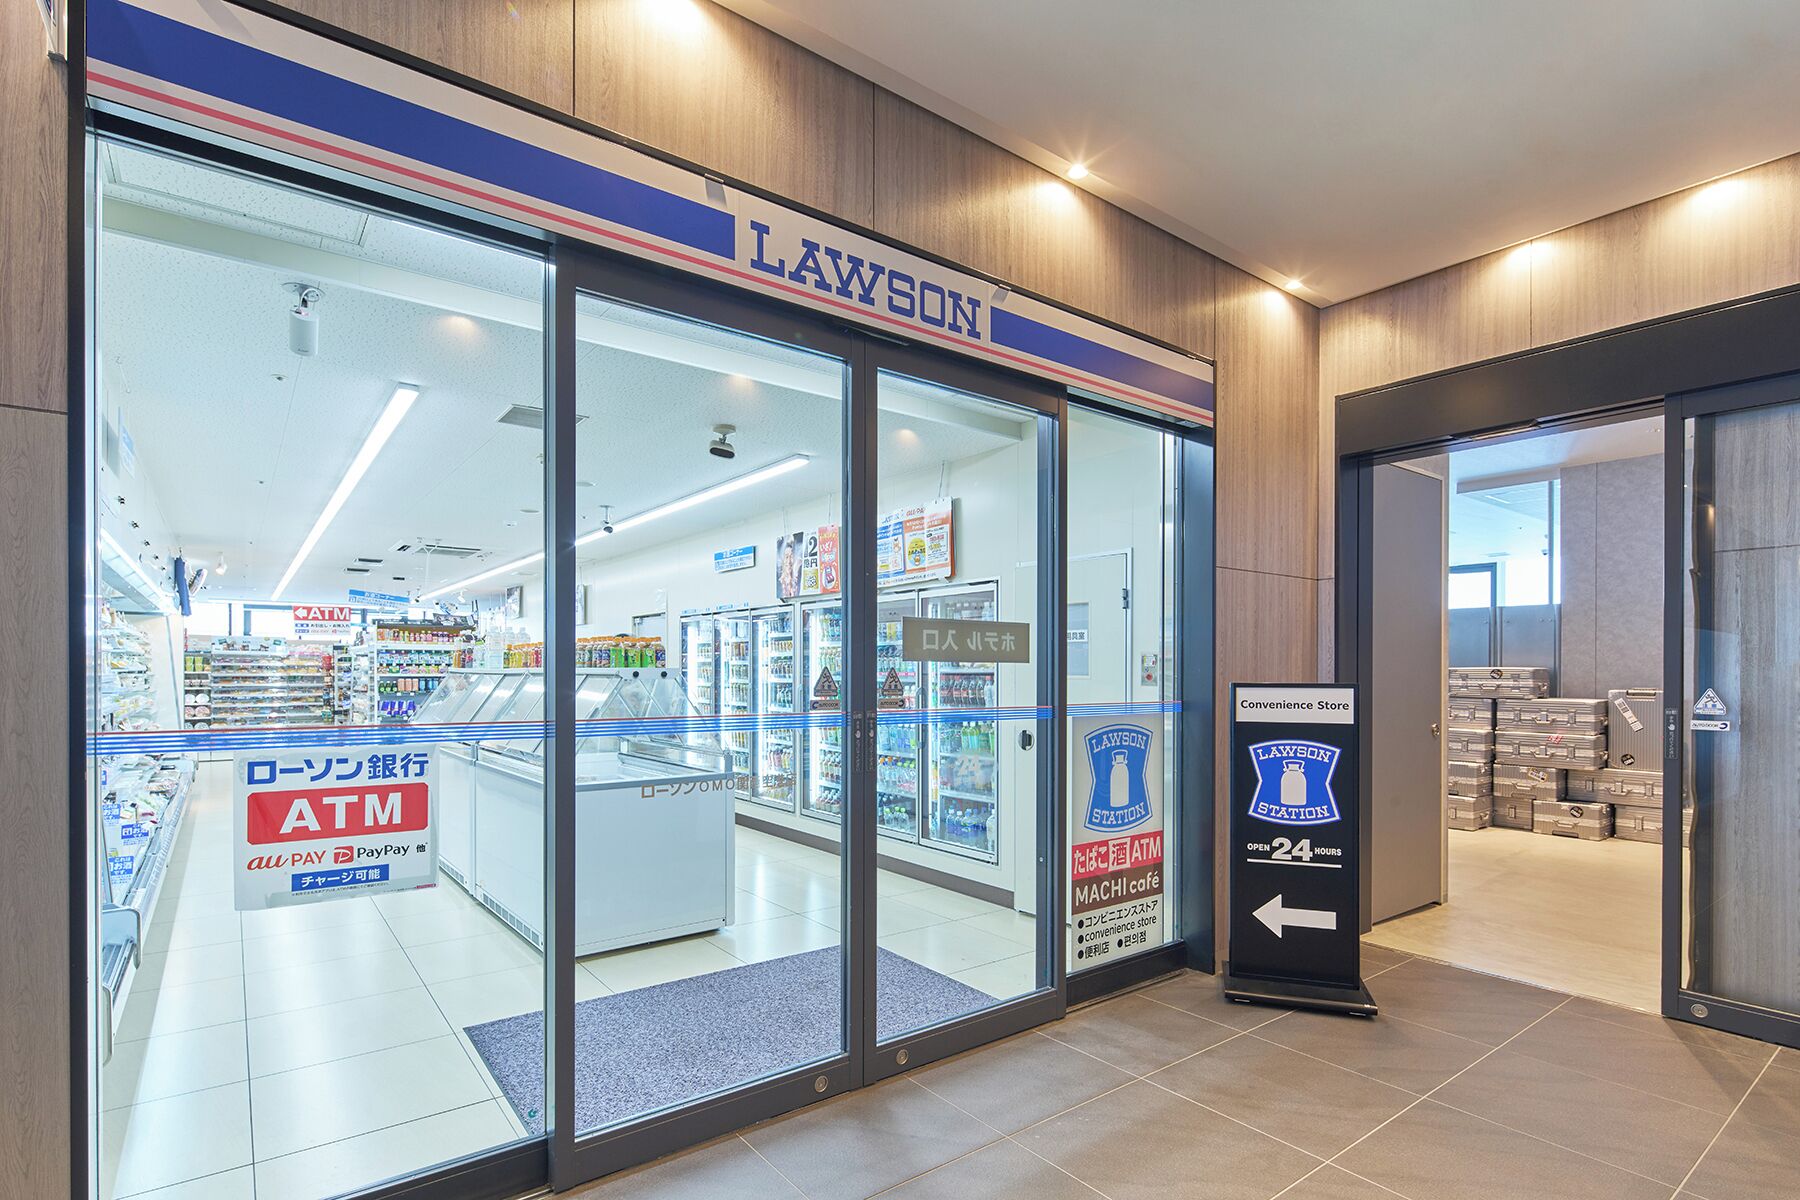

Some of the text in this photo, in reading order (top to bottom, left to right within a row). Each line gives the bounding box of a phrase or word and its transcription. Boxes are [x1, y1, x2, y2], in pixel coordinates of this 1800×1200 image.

[750, 220, 982, 339] LAWSON
[308, 607, 350, 620] ATM
[1240, 699, 1350, 711] Convenience Store
[1092, 731, 1147, 753] LAWSON
[1257, 745, 1332, 763] LAWSON
[247, 752, 429, 785] ローソン銀行
[279, 792, 402, 834] ATM
[1092, 801, 1147, 824] STATION
[1257, 801, 1330, 819] STATION
[247, 850, 326, 870] au PAY
[357, 844, 410, 859] PayPay
[1073, 836, 1161, 874] たばこ 酒 ATM
[1247, 836, 1342, 862] OPEN 24 HOURS
[301, 868, 381, 888] チャージ可能
[1075, 870, 1160, 907] MACHI café
[1085, 900, 1158, 928] コンビニエンスストア
[1084, 915, 1157, 943] convenience store
[1123, 930, 1147, 948] 편의점
[1084, 941, 1110, 959] 便利店
